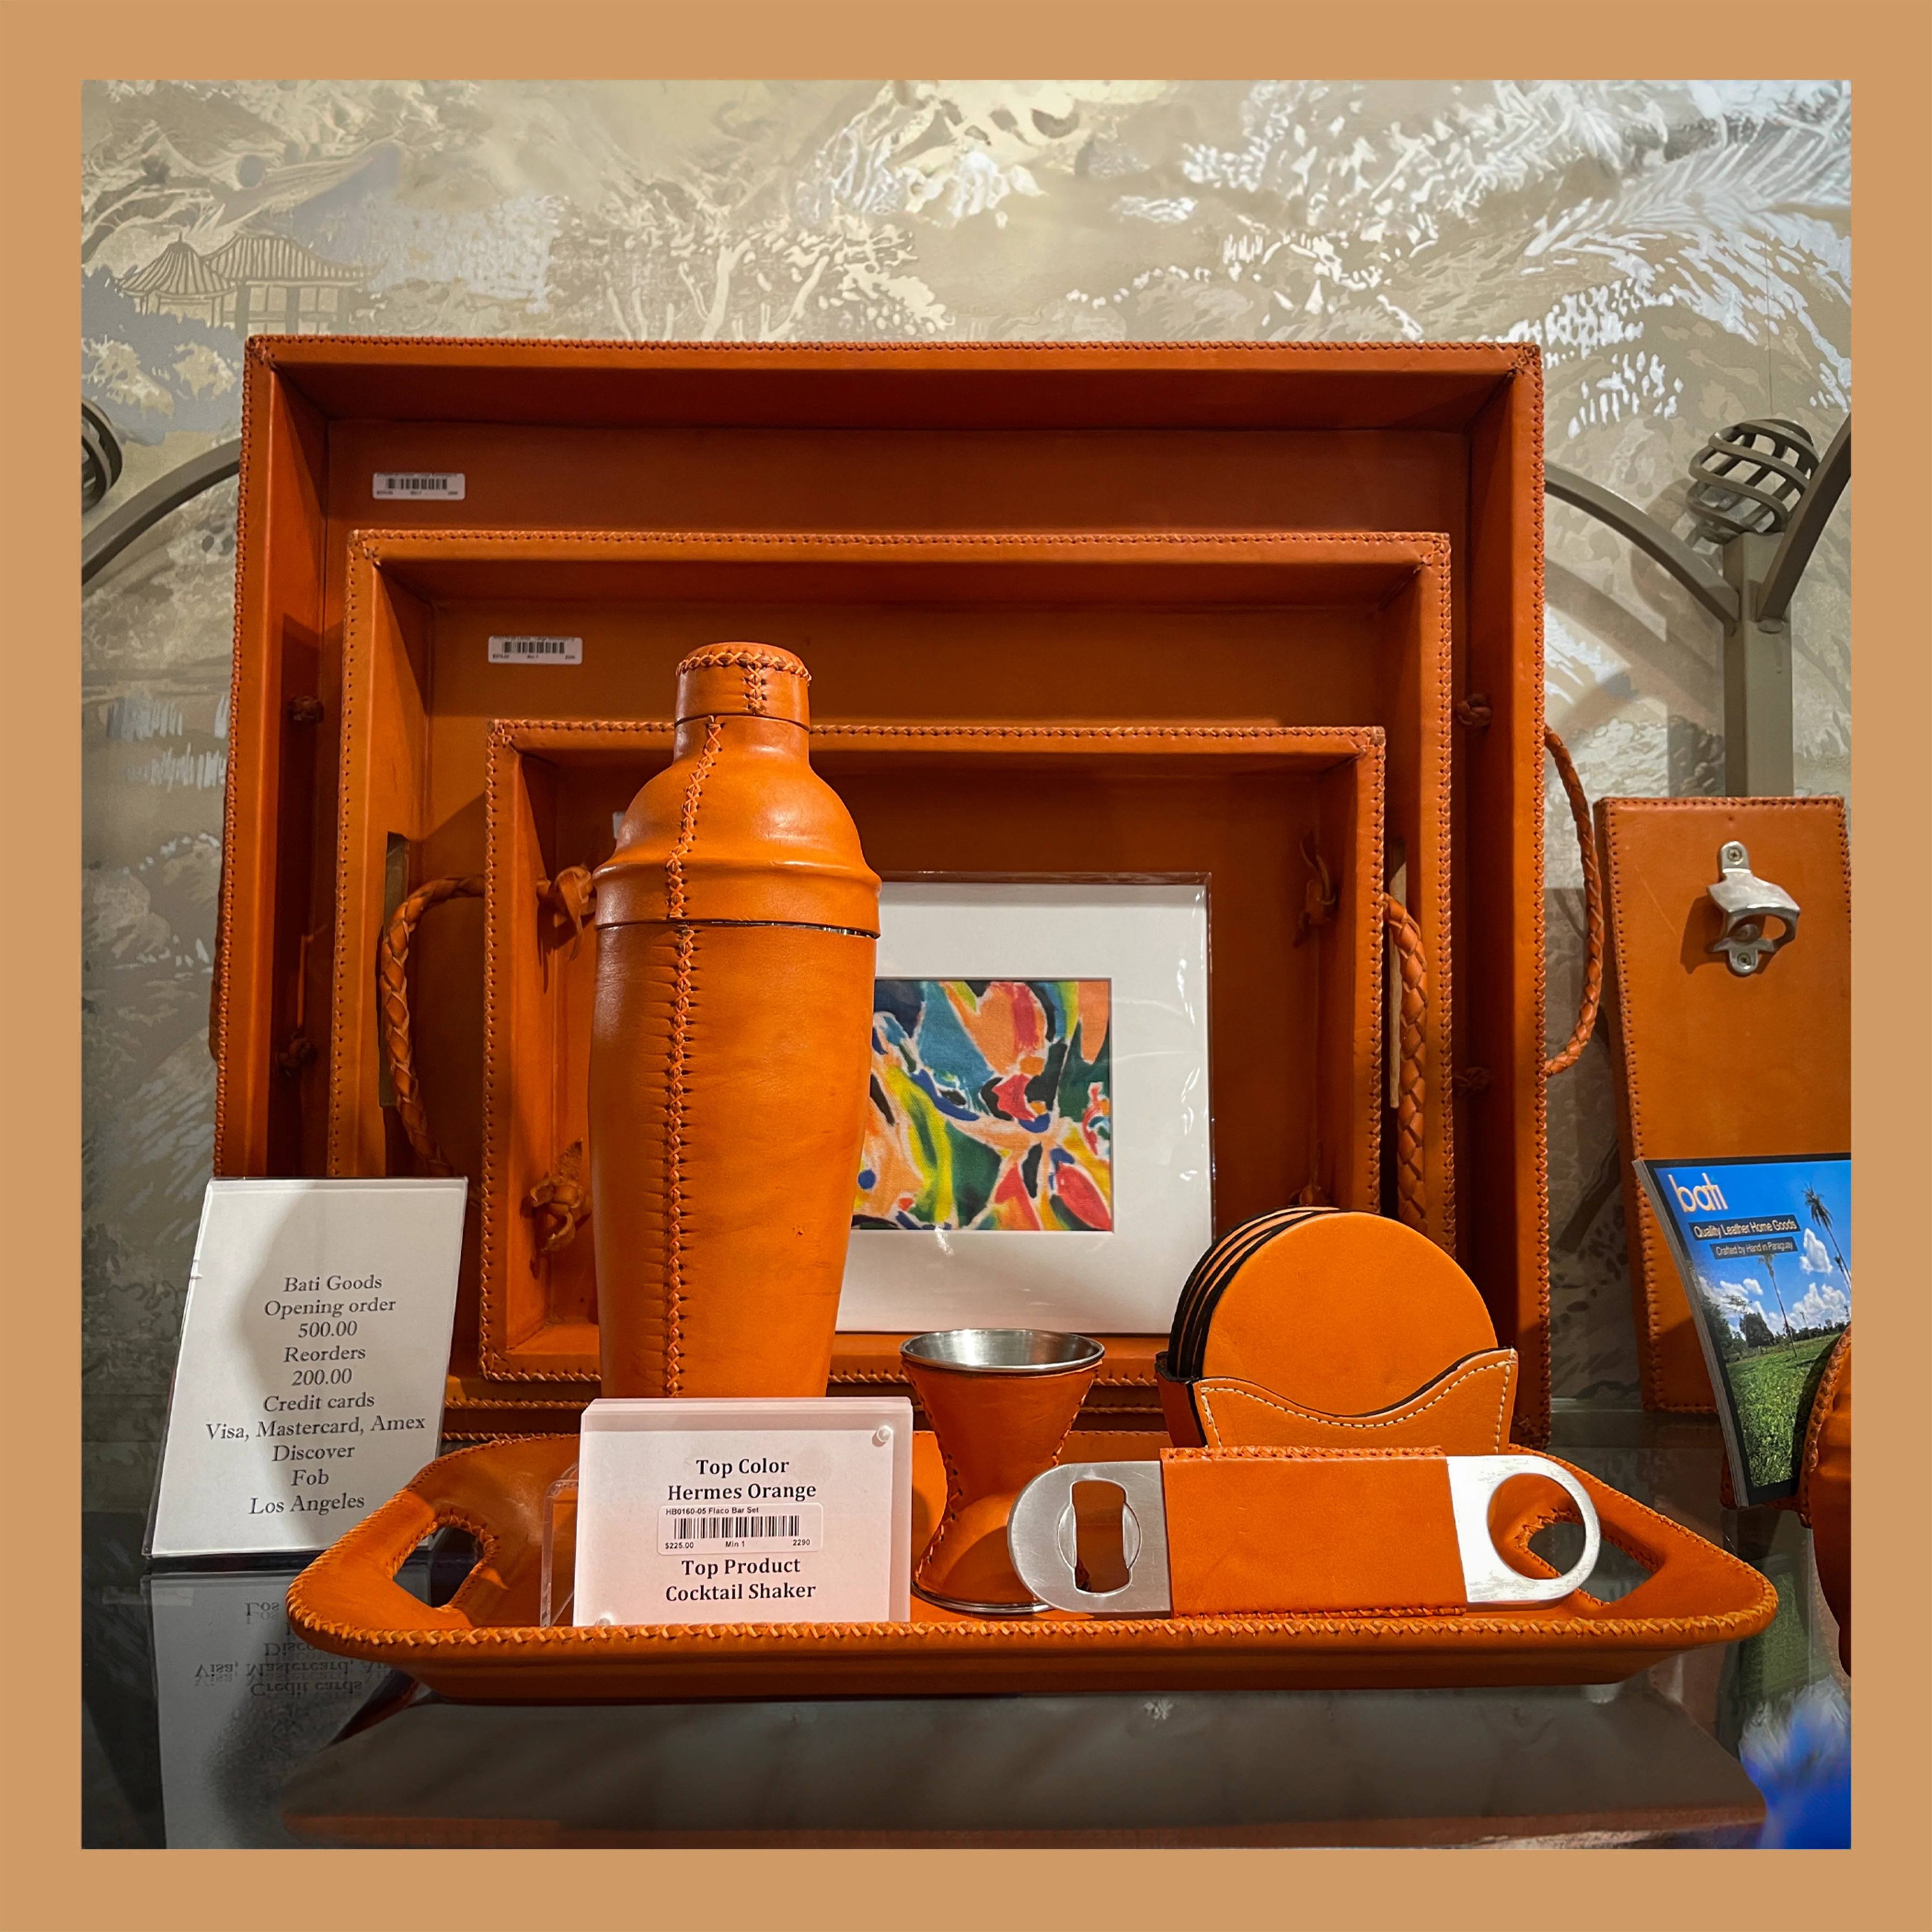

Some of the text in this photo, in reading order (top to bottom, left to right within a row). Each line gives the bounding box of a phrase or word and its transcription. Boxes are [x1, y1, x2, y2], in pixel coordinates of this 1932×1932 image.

[1668, 1172, 1728, 1213] bati
[1693, 1218, 1797, 1239] Quality Leather Home Goods
[1715, 1245, 1738, 1256] Crafted
[1737, 1244, 1746, 1255] by
[1745, 1243, 1762, 1253] Hand
[283, 1274, 382, 1293] Bati Goods
[264, 1296, 397, 1319] Opening order
[298, 1321, 357, 1338] 500.00
[283, 1345, 366, 1363] Reorders
[291, 1368, 352, 1386] 200.00
[263, 1392, 375, 1412] Credit cards
[205, 1415, 426, 1442] Visa, Mastercard, Amex
[272, 1445, 355, 1462] Discover
[291, 1468, 329, 1487] Fob
[696, 1457, 790, 1479] Top Color
[668, 1483, 816, 1502] Hermes Orange
[249, 1492, 365, 1515] Los Angeles
[681, 1557, 801, 1579] Top Product
[666, 1582, 816, 1602] Cocktail Shaker
